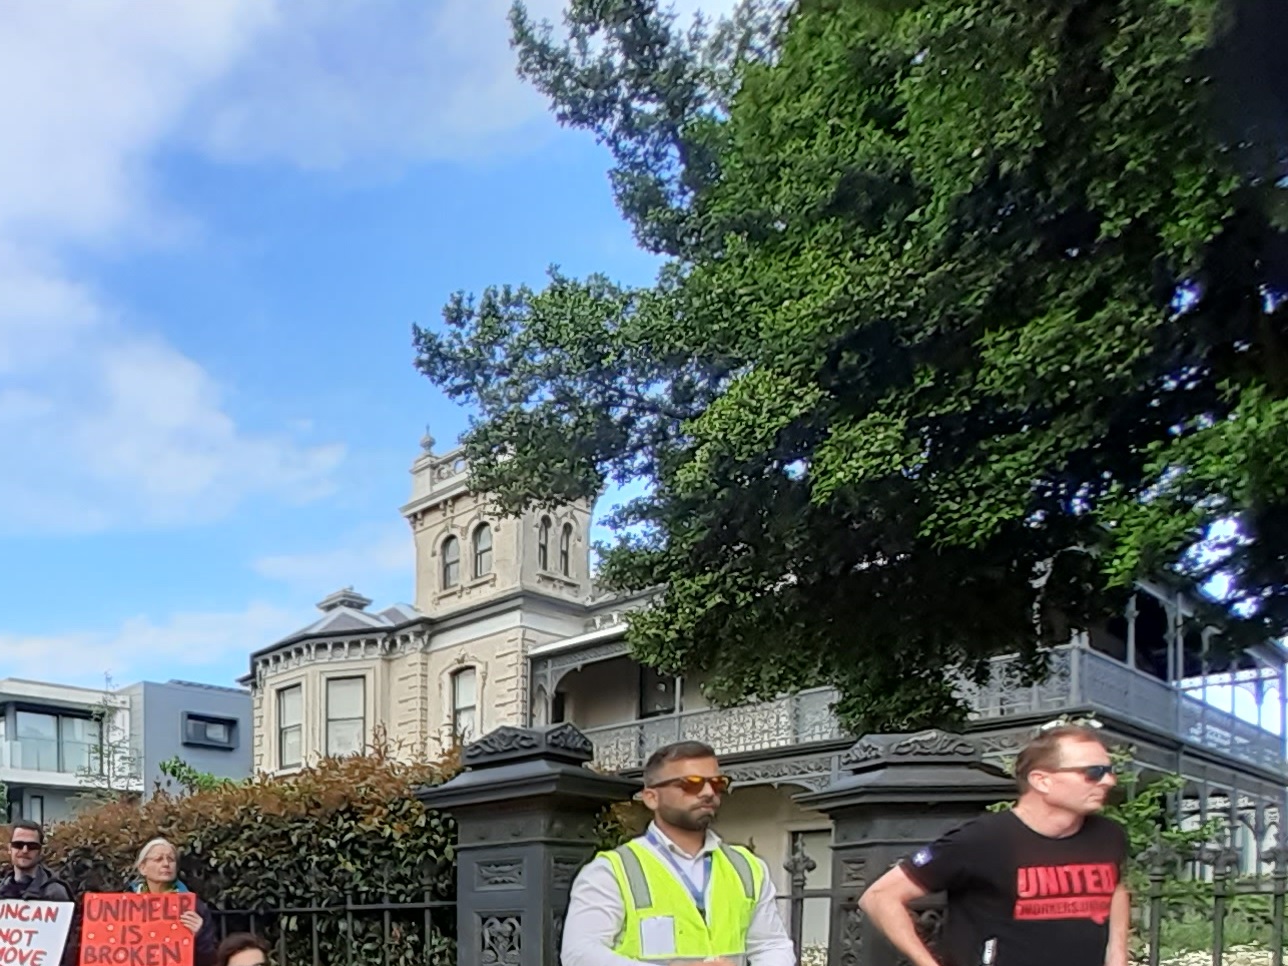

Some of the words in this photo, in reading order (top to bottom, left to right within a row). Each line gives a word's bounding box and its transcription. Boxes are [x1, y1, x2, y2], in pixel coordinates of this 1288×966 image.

[1017, 863, 1117, 897] UNITED
[120, 925, 143, 945] IS
[84, 941, 182, 966] BROKEN
